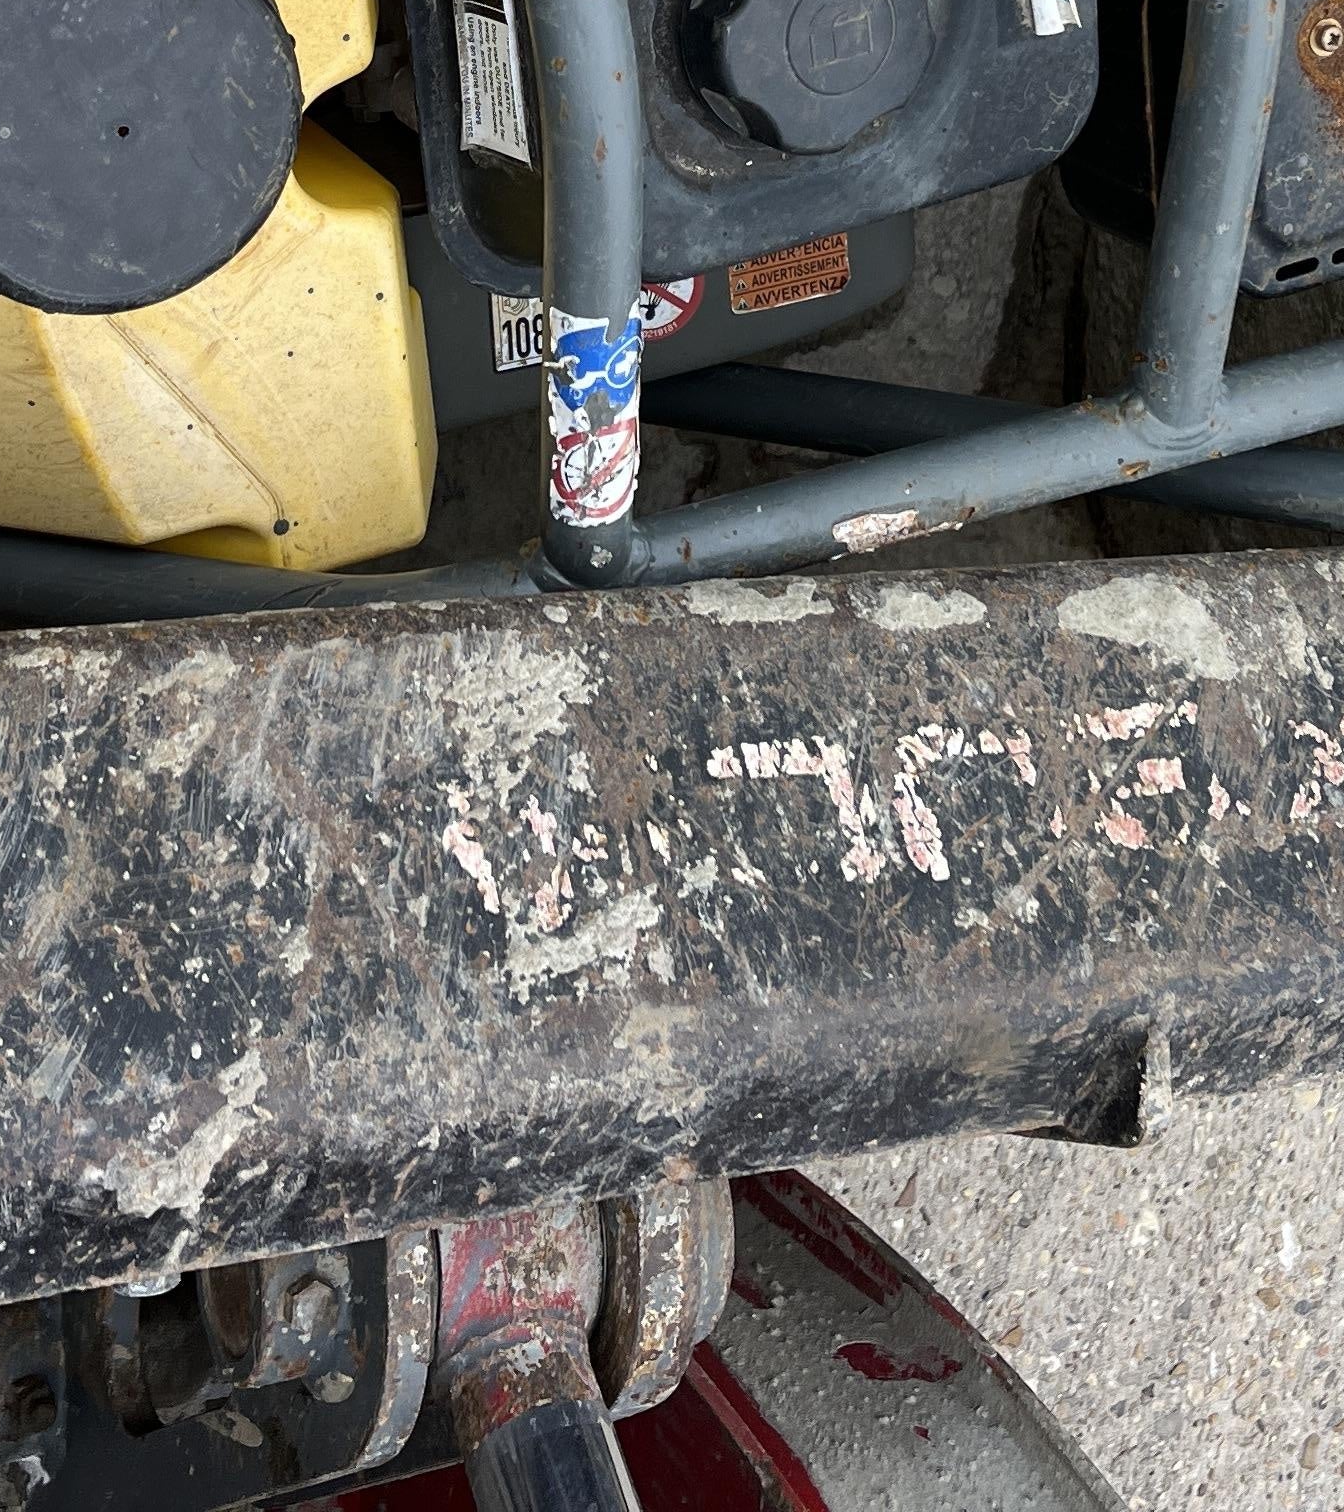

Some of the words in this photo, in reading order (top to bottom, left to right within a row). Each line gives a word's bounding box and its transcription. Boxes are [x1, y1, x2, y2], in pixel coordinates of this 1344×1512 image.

[467, 17, 476, 43] Using
[470, 45, 476, 56] an
[471, 58, 479, 89] engine
[495, 65, 503, 107] OUTSIDE
[474, 91, 482, 125] indoors
[751, 254, 846, 288] ADVERTISSEMENT
[753, 274, 849, 307] AVVERTENZA
